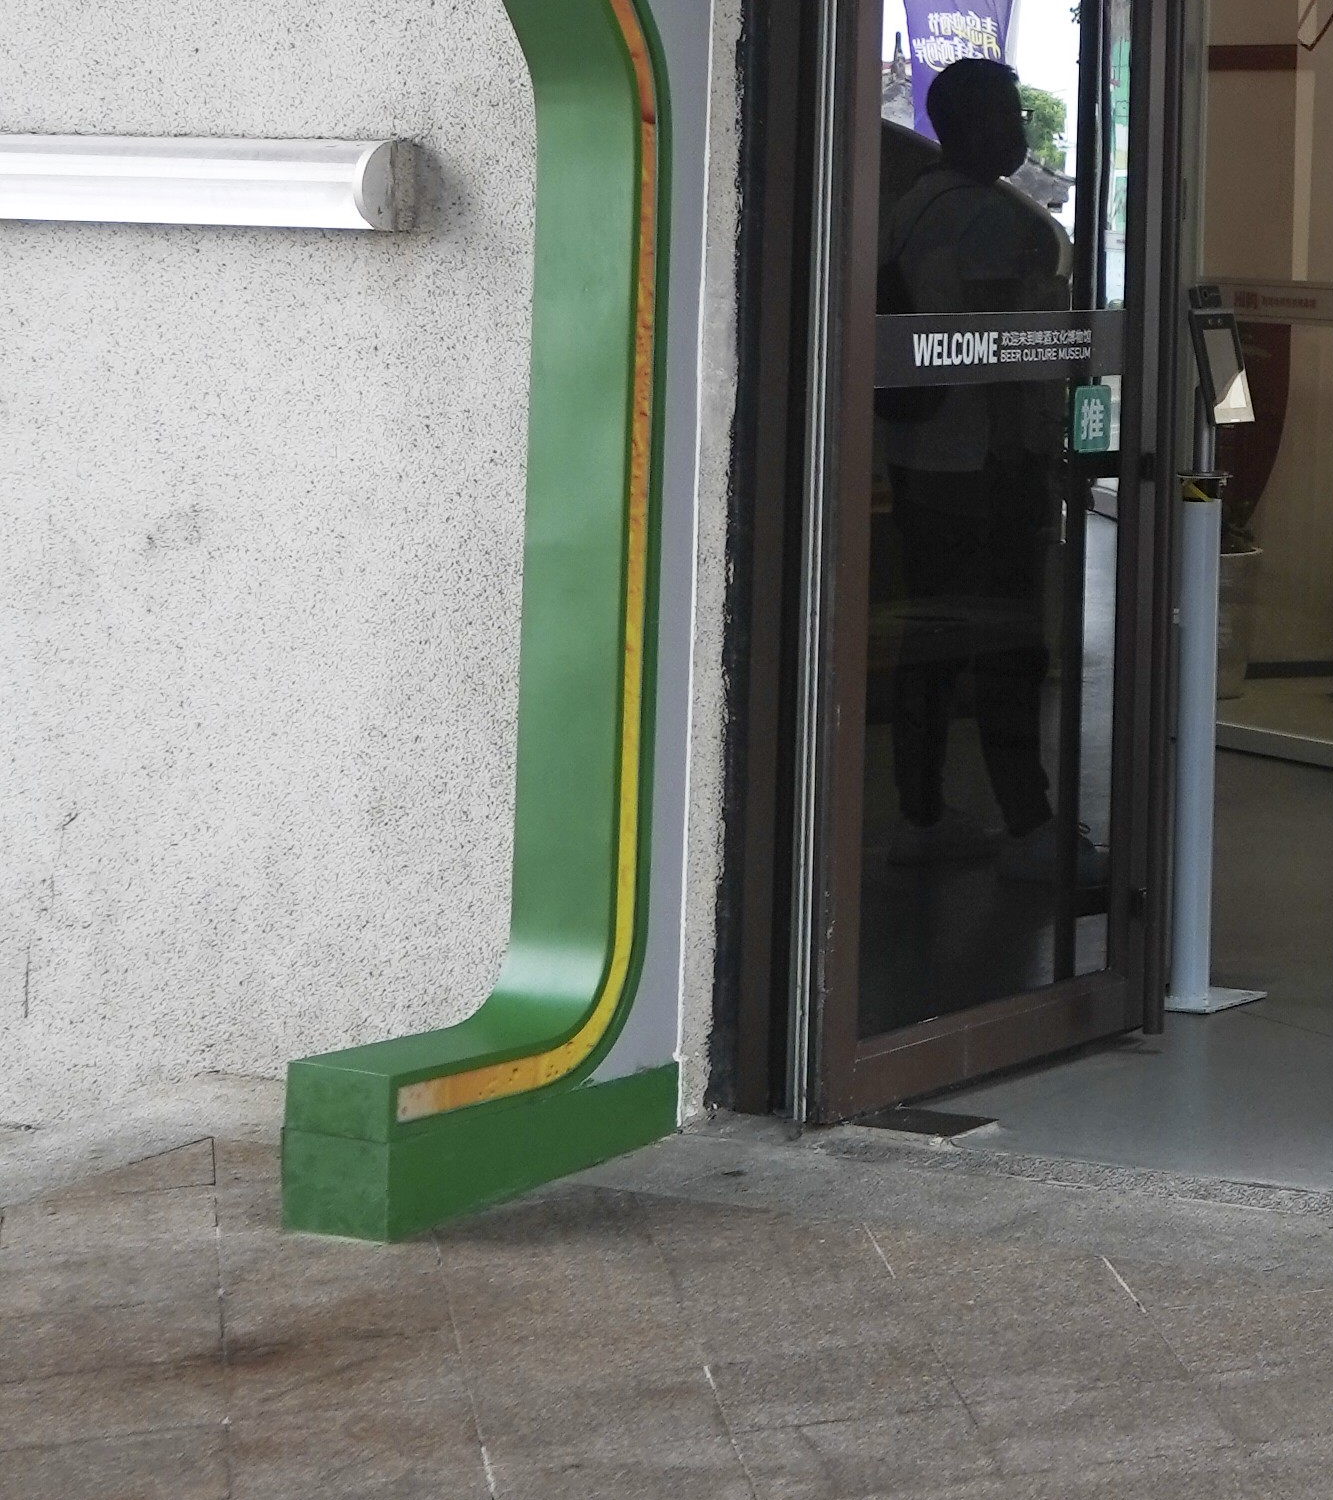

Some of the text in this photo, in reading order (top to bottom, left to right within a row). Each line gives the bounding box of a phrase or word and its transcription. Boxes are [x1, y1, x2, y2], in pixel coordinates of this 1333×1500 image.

[913, 331, 999, 368] WELCOME
[1000, 346, 1092, 363] BEER CULTURE MUSEUM
[1080, 397, 1105, 441] 推
